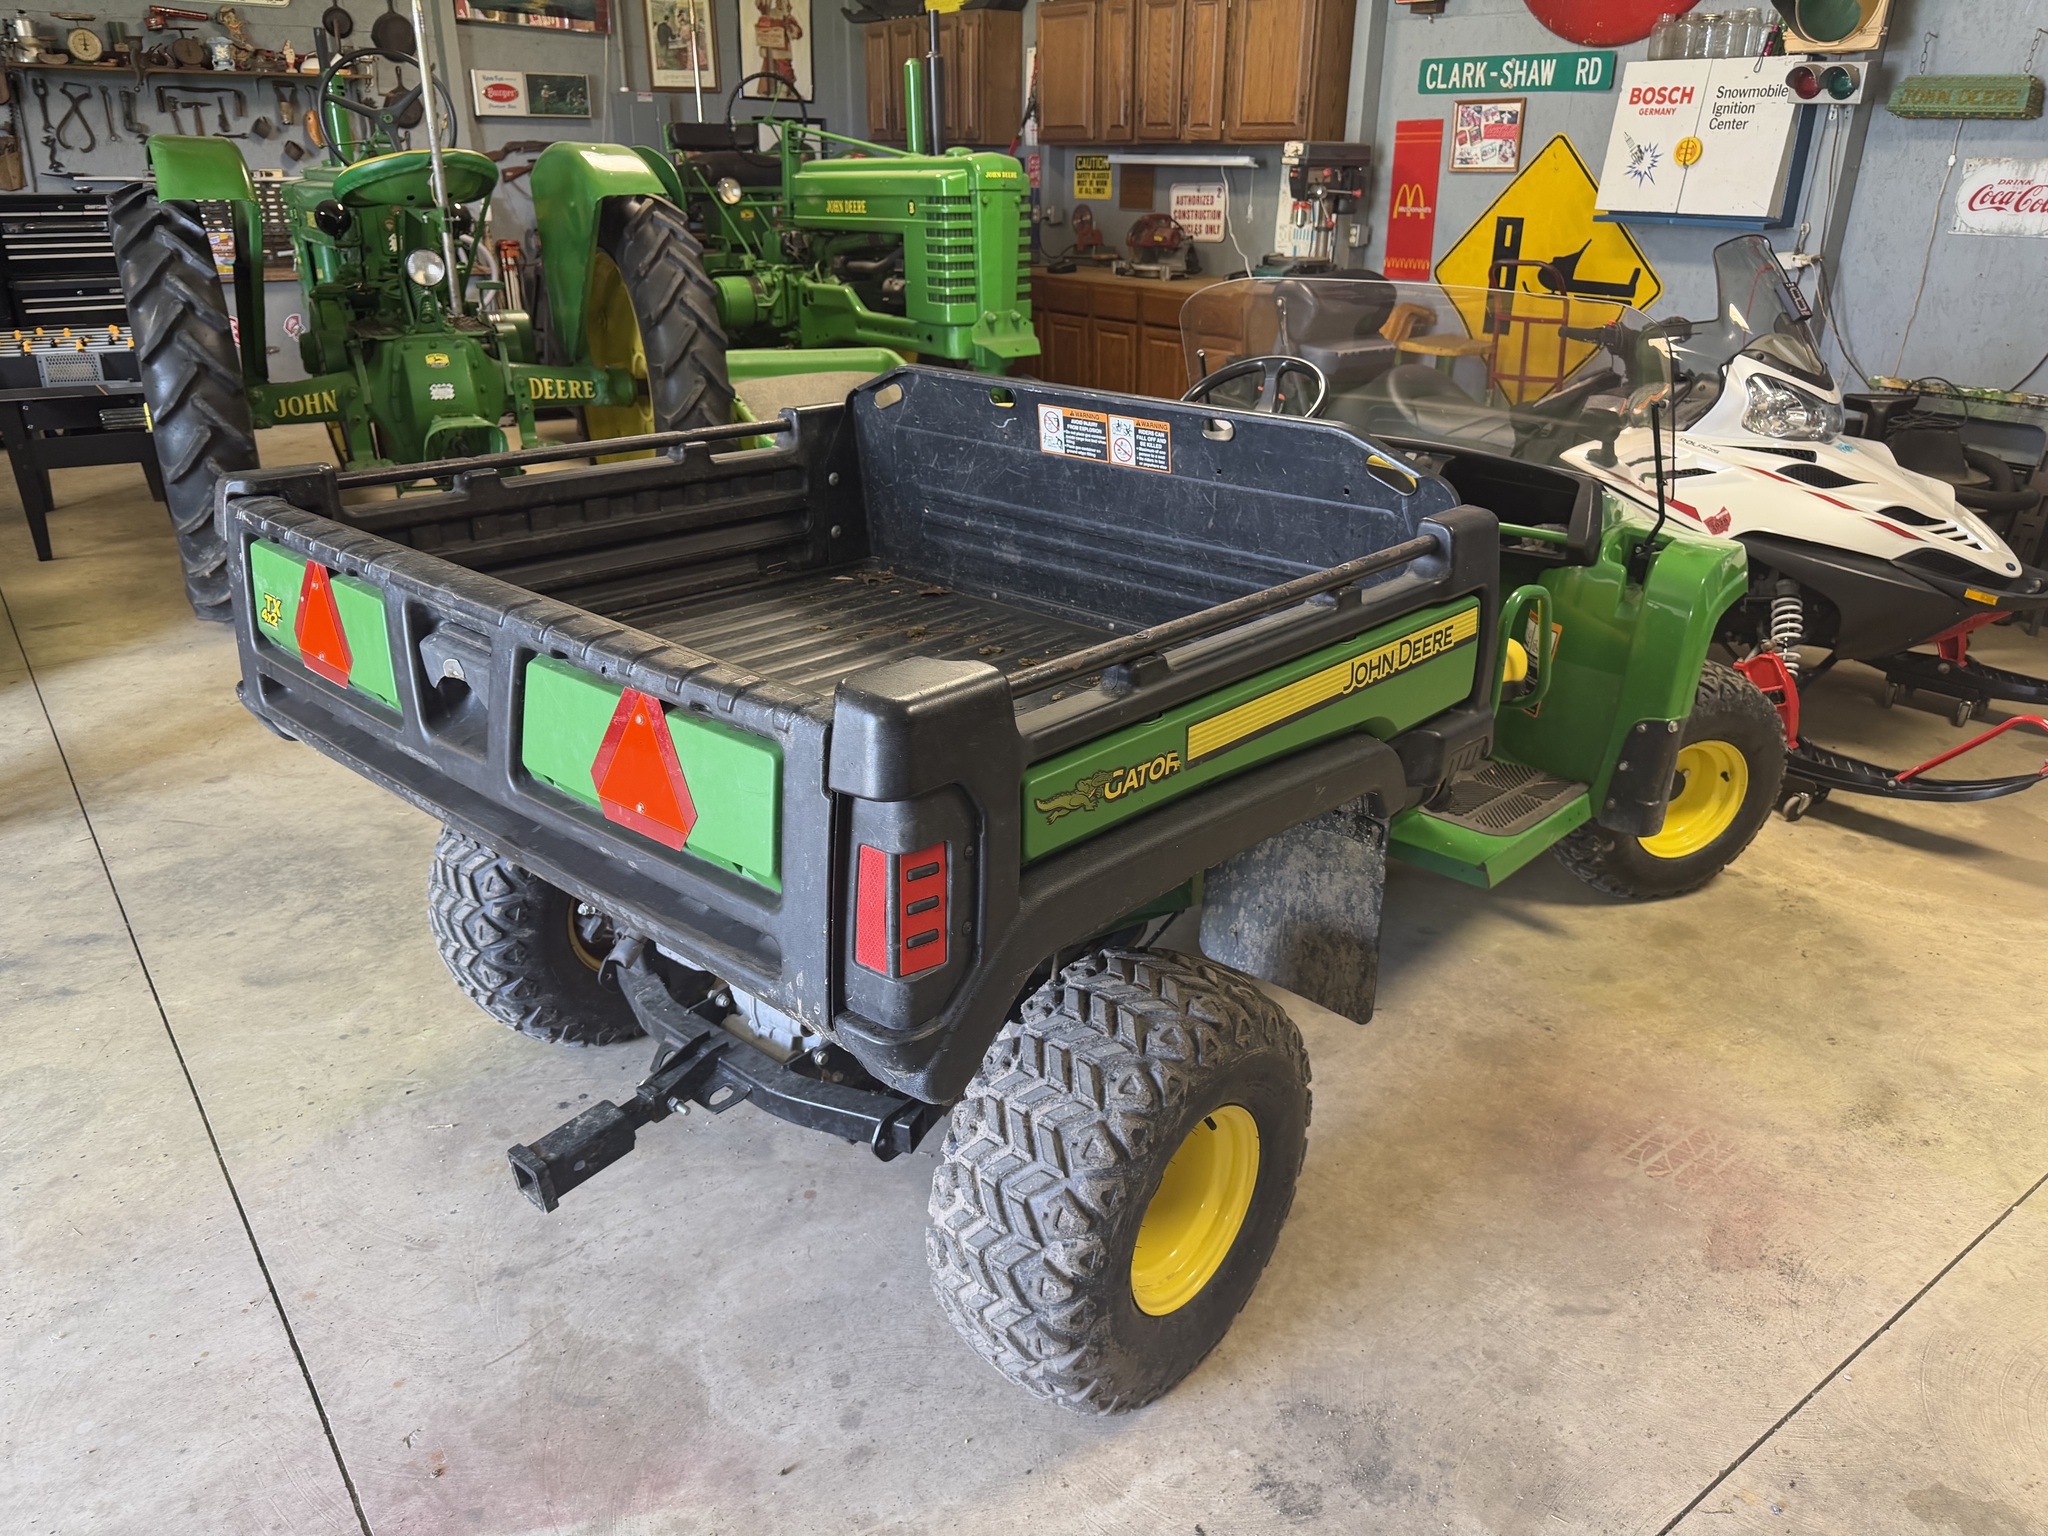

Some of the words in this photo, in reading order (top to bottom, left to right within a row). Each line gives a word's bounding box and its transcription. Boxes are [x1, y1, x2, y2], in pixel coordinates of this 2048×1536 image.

[1426, 58, 1556, 89] CLARK-SHAW
[1575, 57, 1602, 85] RD
[1629, 86, 1695, 105] BOSCH
[1716, 84, 1788, 99] Snowmobile
[1899, 88, 1952, 104] JOHN
[1956, 88, 2022, 105] DEERE
[1638, 107, 1677, 116] GERMANY
[1712, 102, 1756, 115] Ignition
[1709, 118, 1749, 130] Center
[1176, 195, 1214, 206] AUTHORIZED
[1968, 183, 2048, 213] Coca-Col
[826, 200, 844, 214] JOHN
[845, 200, 867, 214] DEERE
[1174, 210, 1221, 220] CONSTRUCTION
[1205, 224, 1220, 235] ONLY
[528, 377, 596, 400] DEERE
[274, 390, 339, 418] JOHN
[1075, 412, 1100, 420] WARNING
[1142, 421, 1168, 430] WARNING
[264, 593, 282, 619] TX
[1343, 650, 1394, 692] JOHN
[1399, 624, 1454, 667] DEERE
[1104, 752, 1181, 799] GATOR
